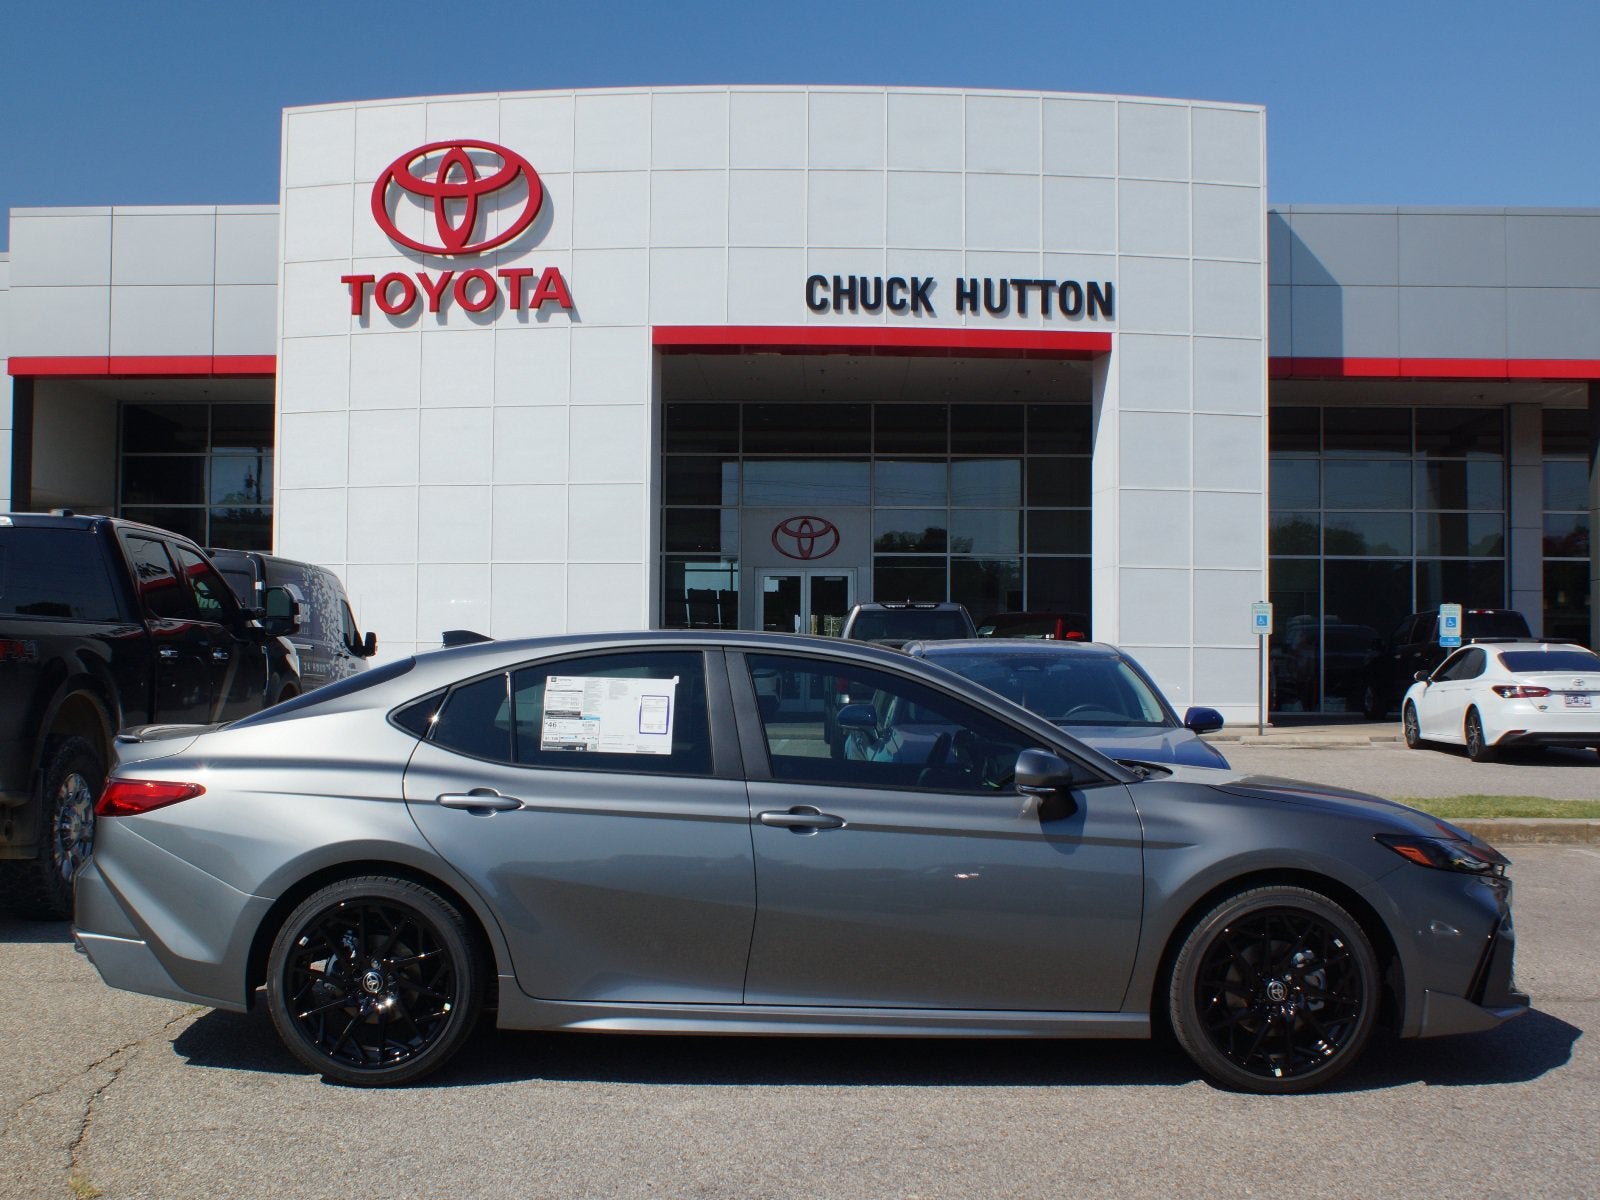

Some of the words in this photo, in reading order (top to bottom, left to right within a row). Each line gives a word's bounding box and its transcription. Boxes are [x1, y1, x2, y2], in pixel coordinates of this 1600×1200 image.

[341, 267, 573, 315] TOYOTA
[806, 275, 934, 313] CHUCK
[956, 278, 1113, 316] HUTTON
